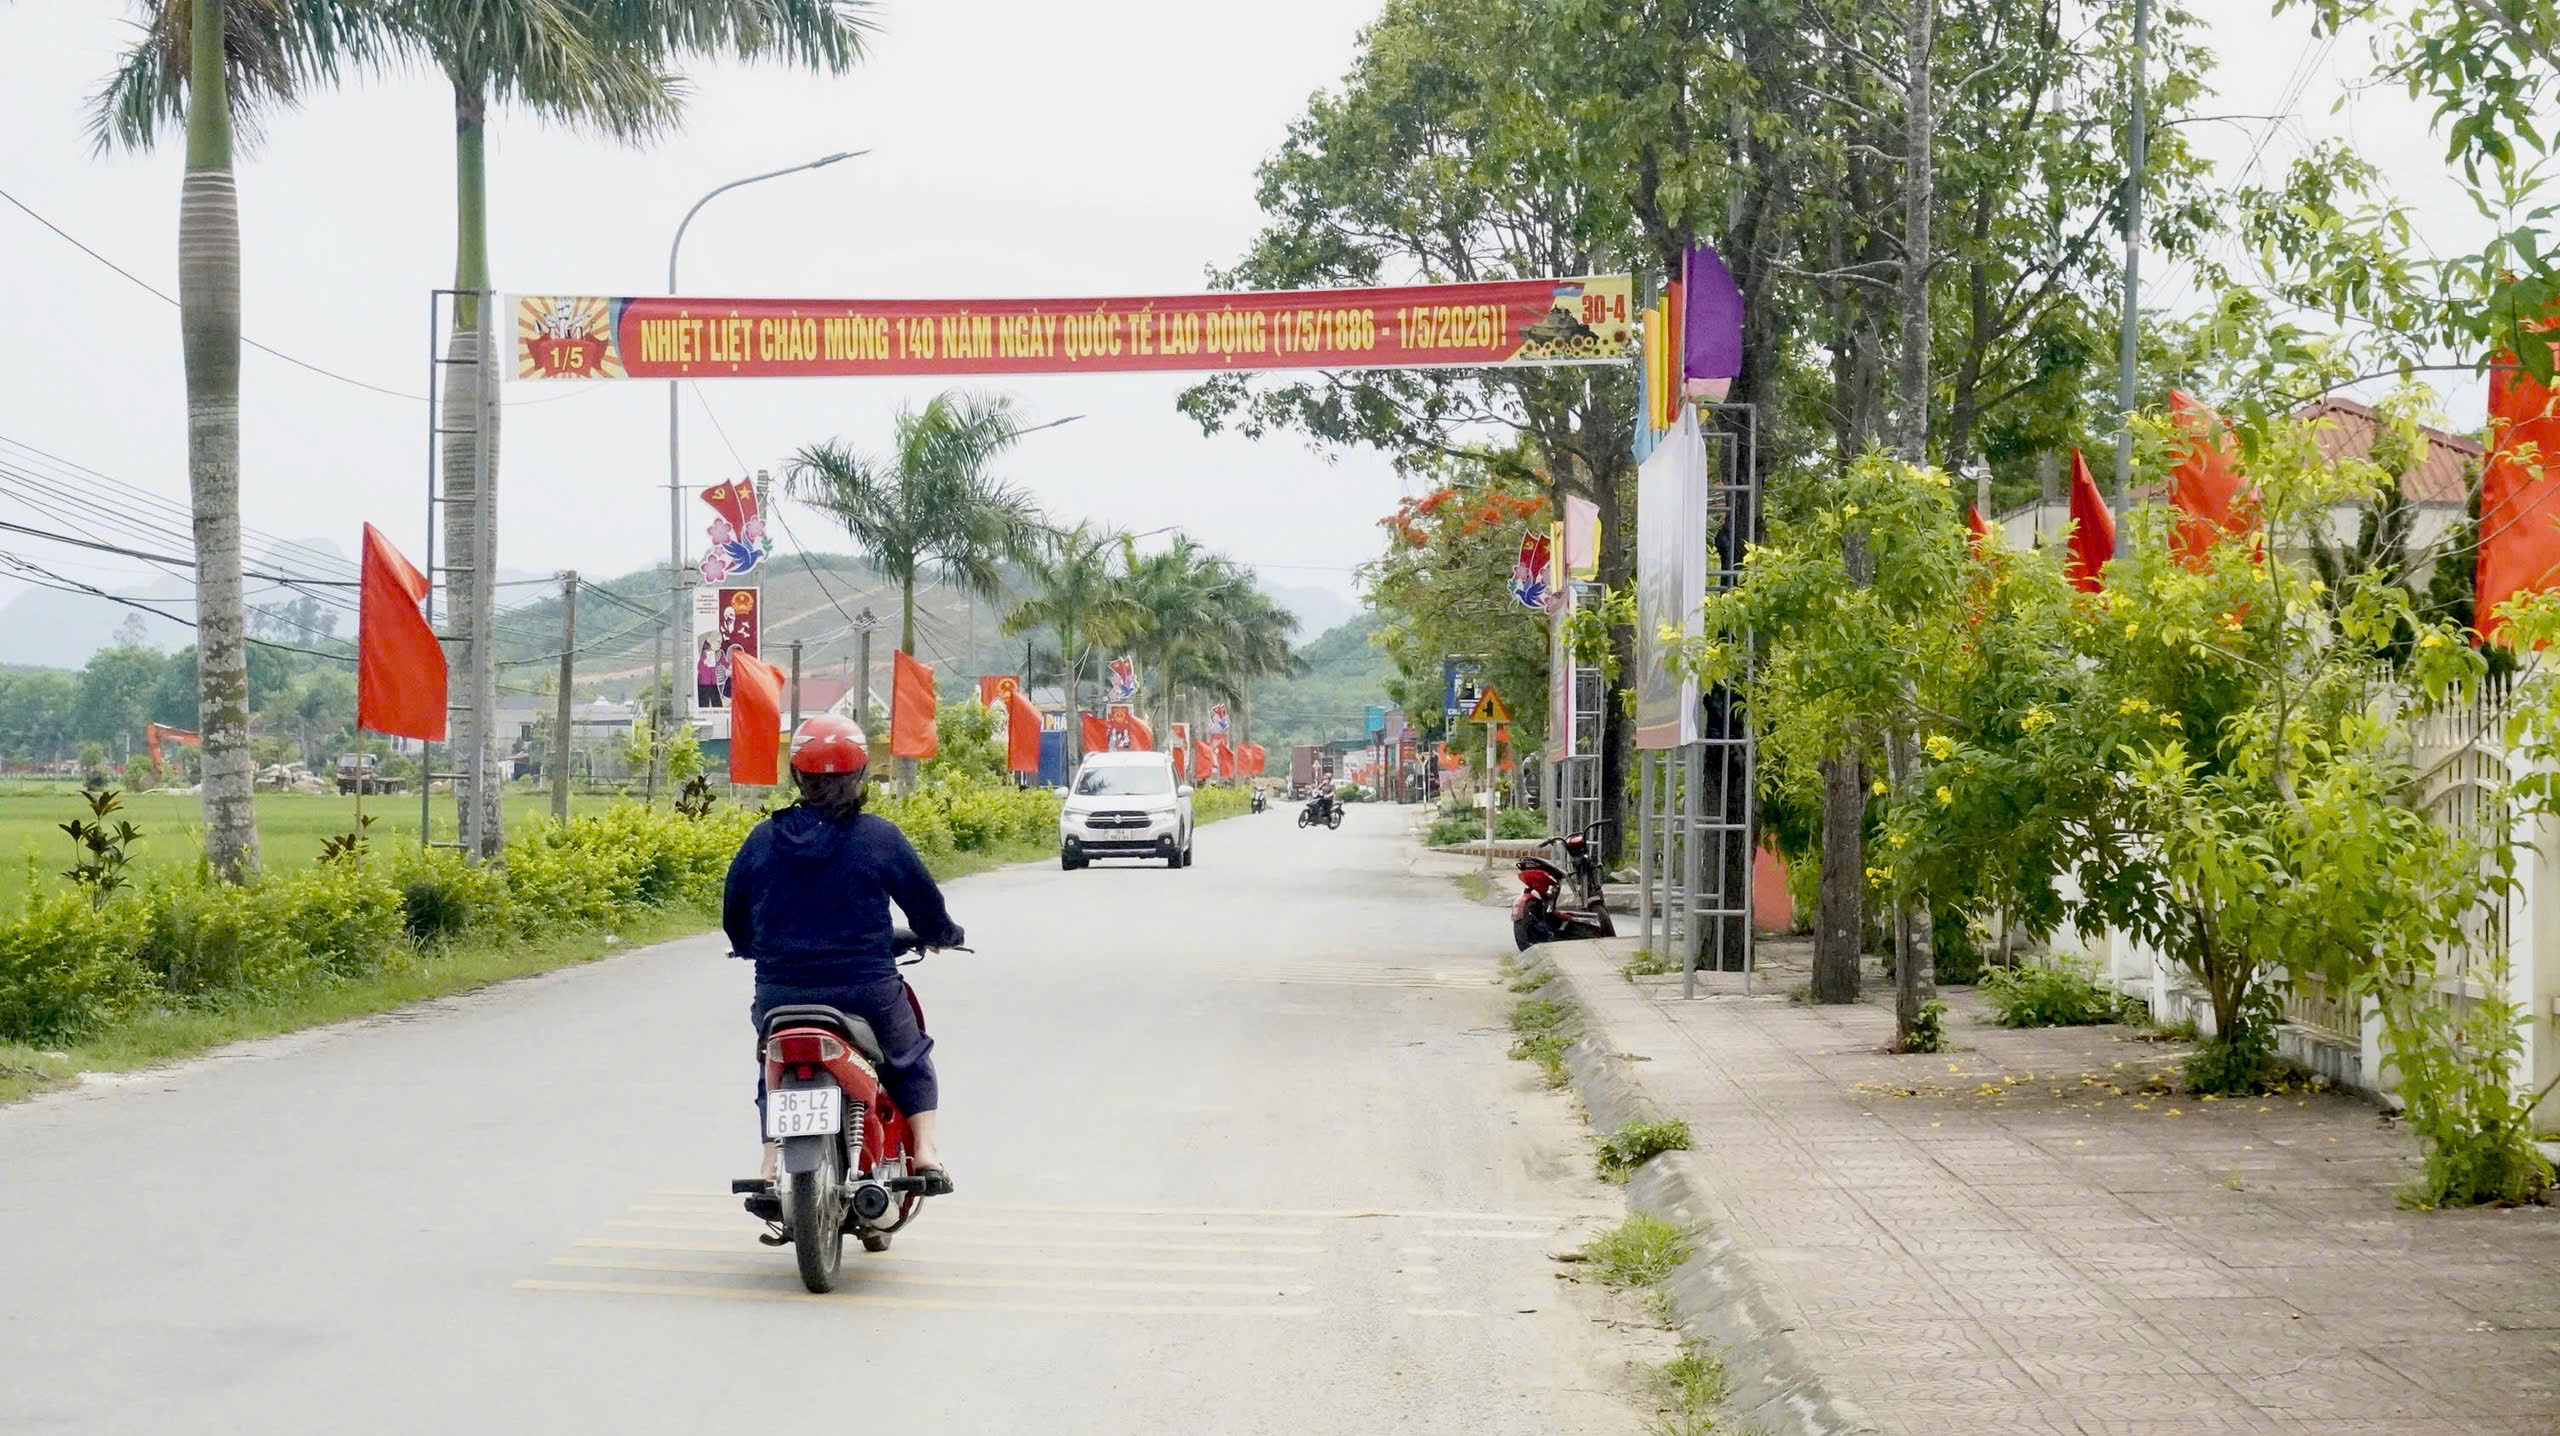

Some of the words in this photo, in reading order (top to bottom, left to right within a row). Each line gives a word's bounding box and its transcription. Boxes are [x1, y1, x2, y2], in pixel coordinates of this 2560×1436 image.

[1581, 294, 1626, 324] 30-4
[641, 310, 703, 372] NHIỆT
[710, 310, 753, 372] LIỆT
[760, 309, 817, 361] CHÀO
[824, 310, 889, 360] MỪNG
[896, 316, 935, 359] 140
[942, 308, 992, 359] NĂM
[1000, 308, 1057, 358] NGÀY
[1064, 301, 1122, 362] QUỐC
[1128, 301, 1154, 356] TẾ
[1160, 312, 1200, 355] LAO
[1206, 304, 1266, 363] ĐỘNG
[1274, 309, 1375, 358] (1/5/1886
[1398, 304, 1507, 351] 1/5/2026)!
[551, 346, 584, 371] 1/5
[778, 1091, 829, 1112] 36-L2
[778, 1112, 829, 1133] 6875
